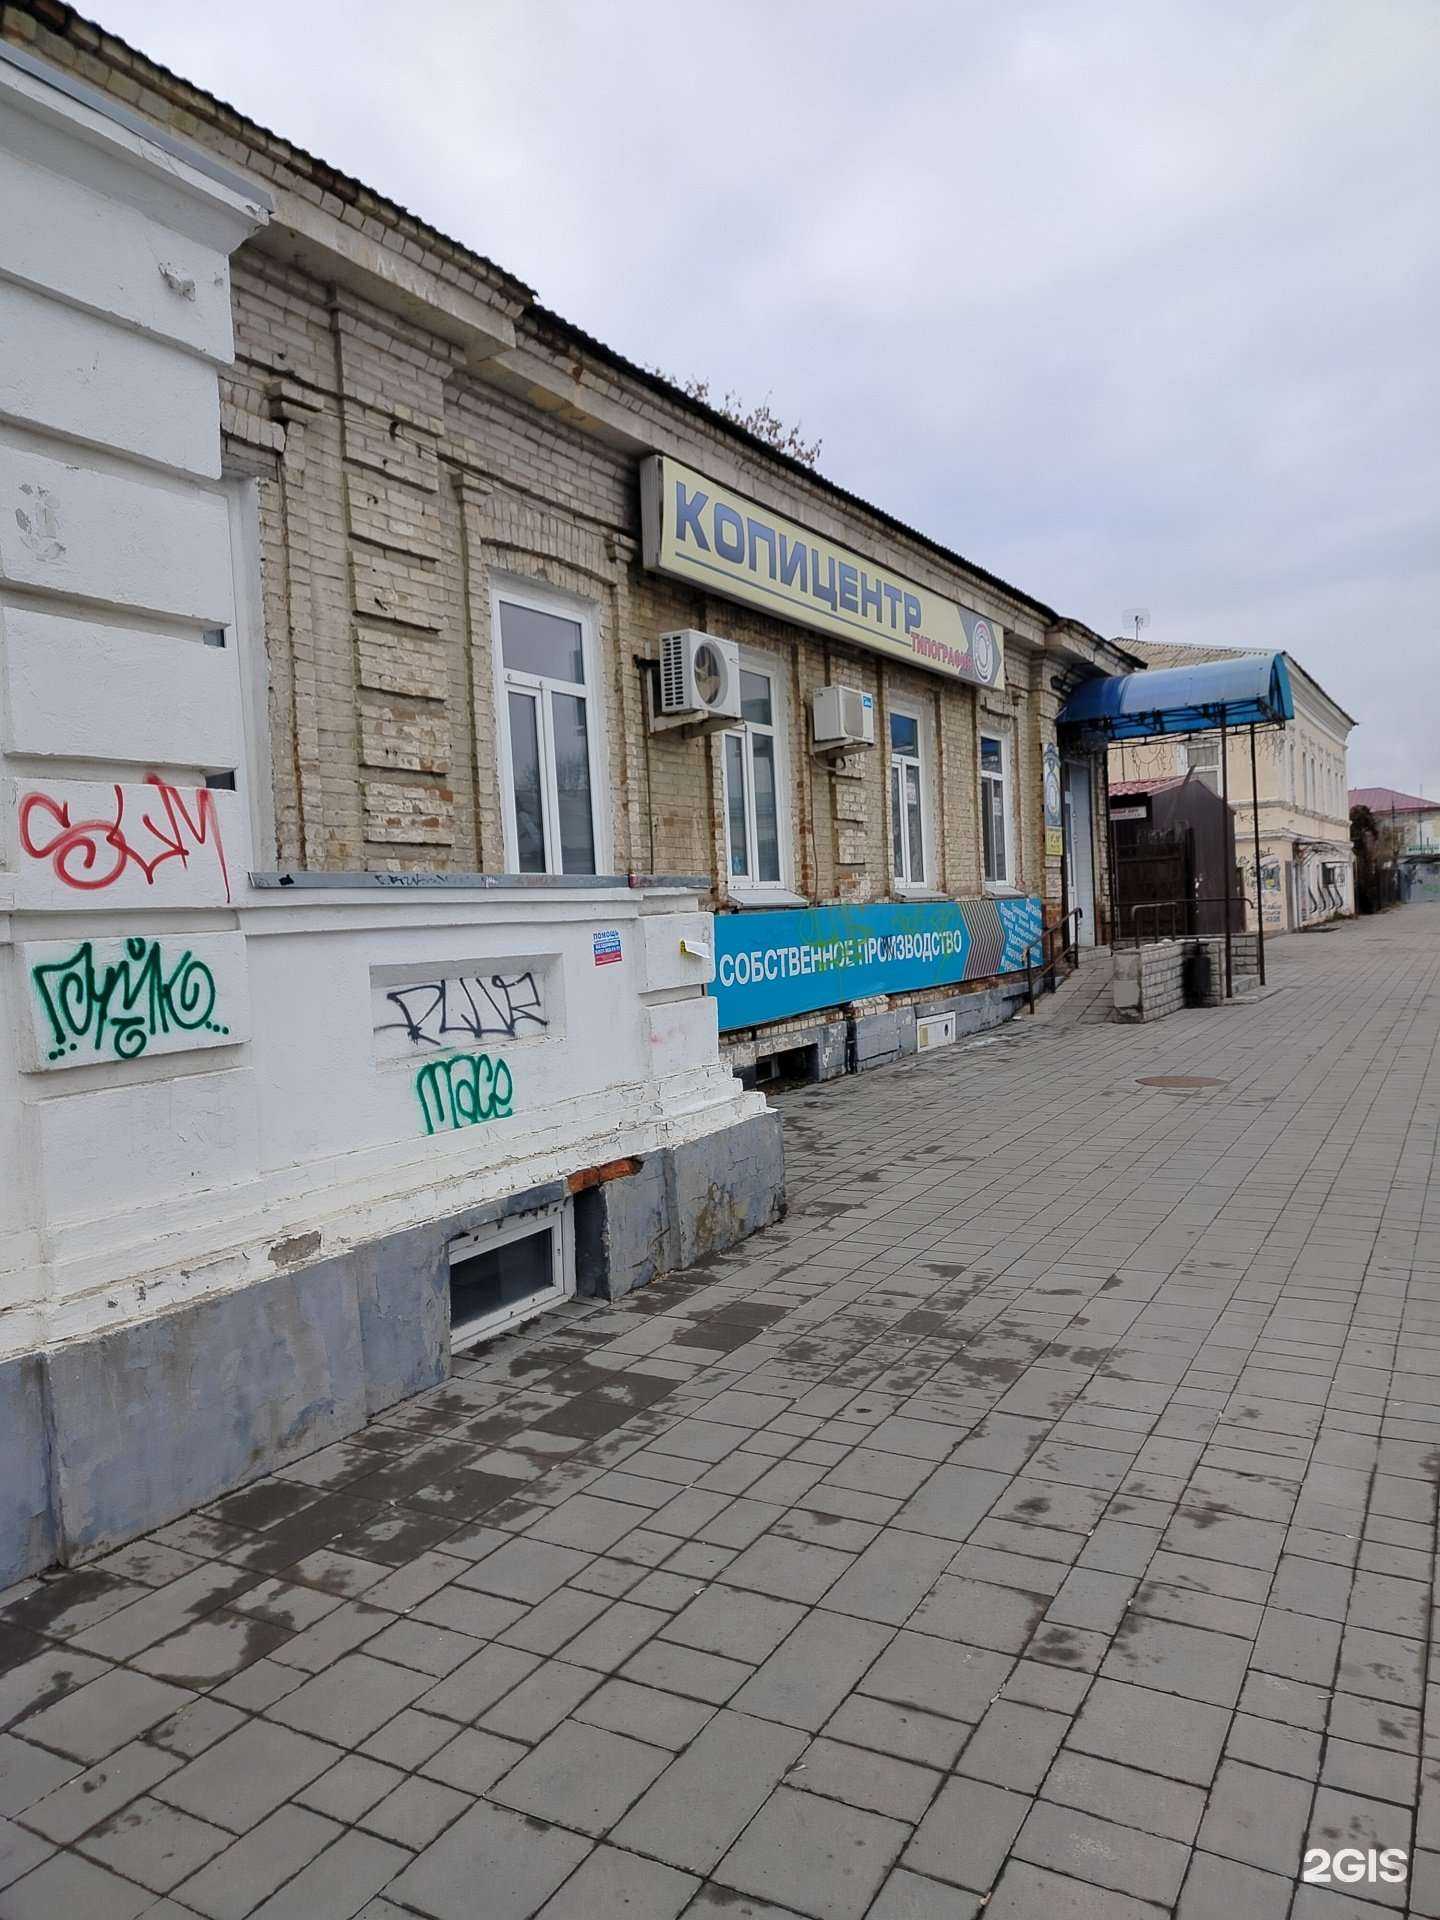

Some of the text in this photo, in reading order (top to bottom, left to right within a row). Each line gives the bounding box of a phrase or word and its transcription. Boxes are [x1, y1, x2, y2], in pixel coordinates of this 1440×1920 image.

[675, 480, 922, 635] КОПИЦЕНТР
[720, 939, 855, 987] СОБСТВЕННОЕ
[858, 930, 962, 966] ПРОИЗВОДСТВО
